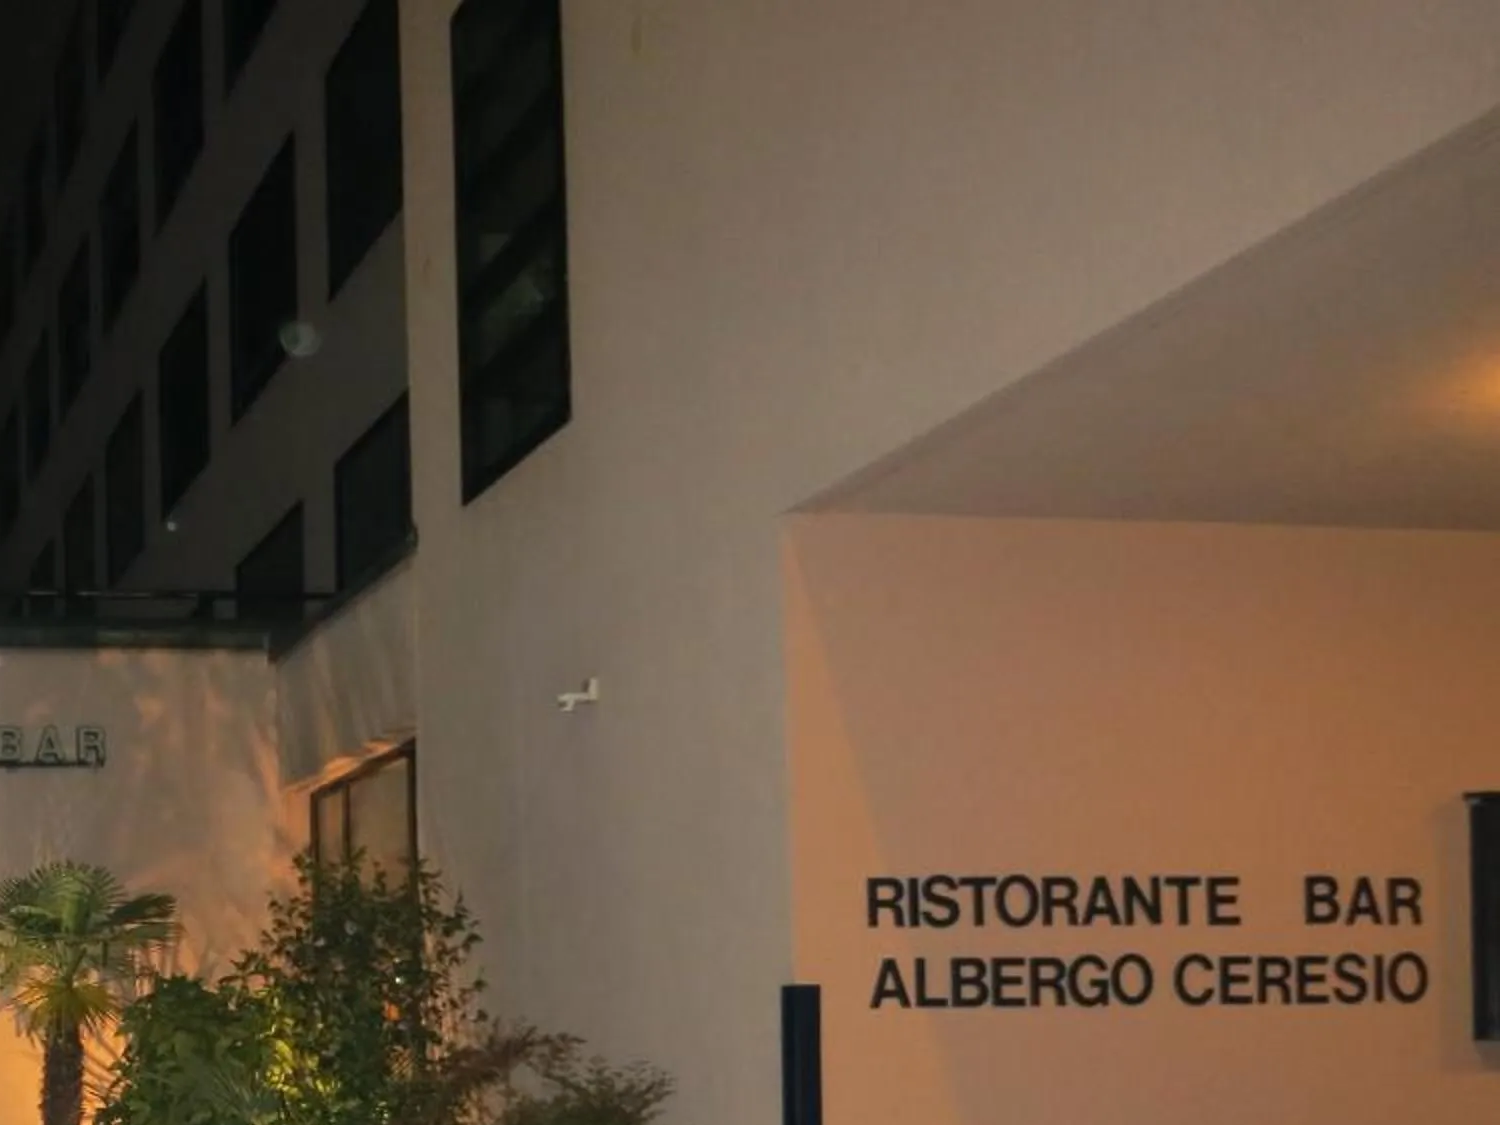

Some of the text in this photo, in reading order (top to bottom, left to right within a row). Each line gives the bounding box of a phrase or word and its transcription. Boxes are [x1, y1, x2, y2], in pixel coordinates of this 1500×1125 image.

[867, 874, 1423, 928] RISTORANTE BAR
[871, 952, 1429, 1009] ALBERGO CERESIO
